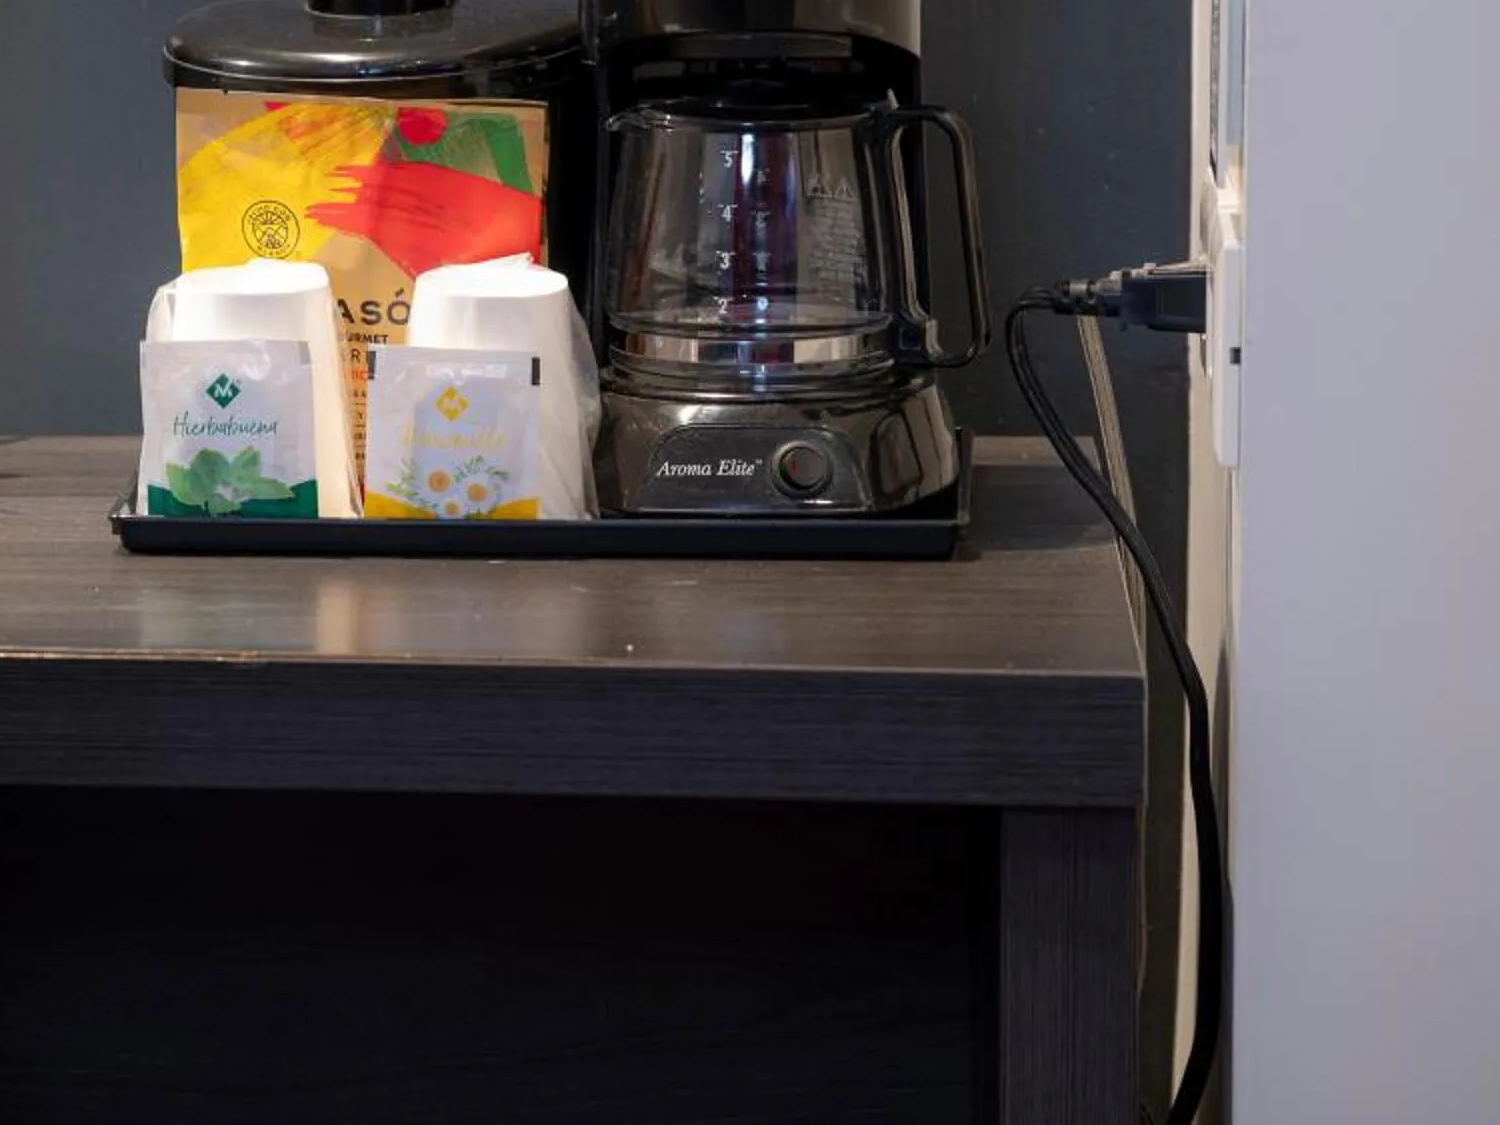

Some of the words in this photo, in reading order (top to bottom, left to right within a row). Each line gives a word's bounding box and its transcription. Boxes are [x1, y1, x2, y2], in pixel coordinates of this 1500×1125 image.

[721, 205, 733, 223] 4
[719, 252, 731, 270] 3
[717, 298, 728, 314] 2
[656, 460, 712, 476] Aroma
